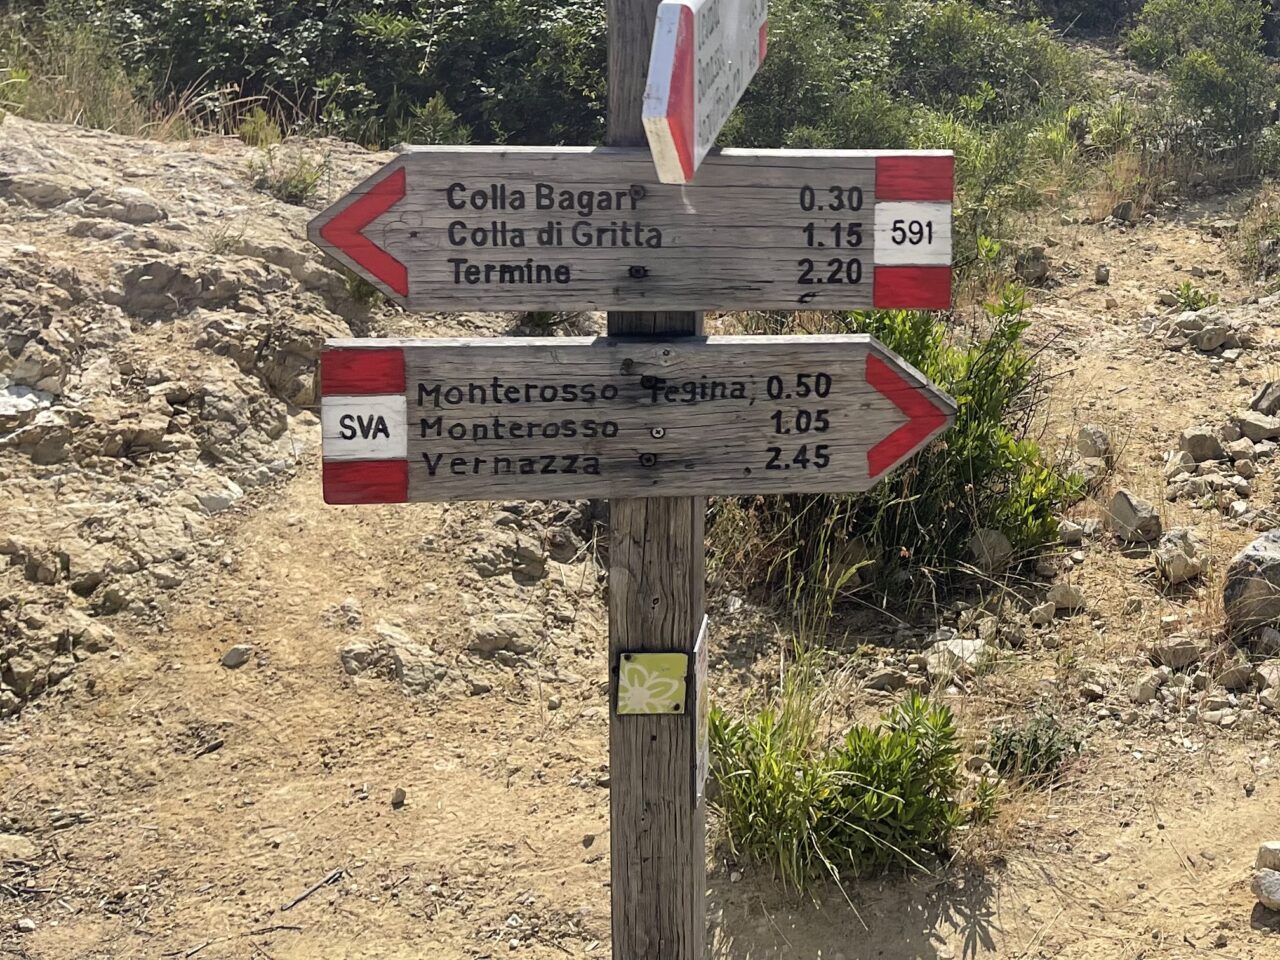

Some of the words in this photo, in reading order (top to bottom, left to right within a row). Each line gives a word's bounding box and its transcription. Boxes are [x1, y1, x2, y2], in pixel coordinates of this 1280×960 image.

[446, 182, 525, 210] Colla
[799, 184, 863, 212] 0.30
[448, 220, 525, 247] Colla
[536, 220, 563, 246] di
[571, 220, 663, 248] Gritta
[802, 221, 863, 248] 1.15
[891, 219, 934, 246] 591
[447, 257, 571, 285] Termine
[797, 258, 862, 285] 2.20
[416, 376, 620, 409] Monterosso
[766, 372, 833, 400] 0.50
[339, 413, 390, 441] SVA
[419, 415, 620, 442] Monterosso
[770, 408, 830, 435] 1.05
[422, 451, 602, 477] Vernazza
[765, 443, 830, 470] 2.45
